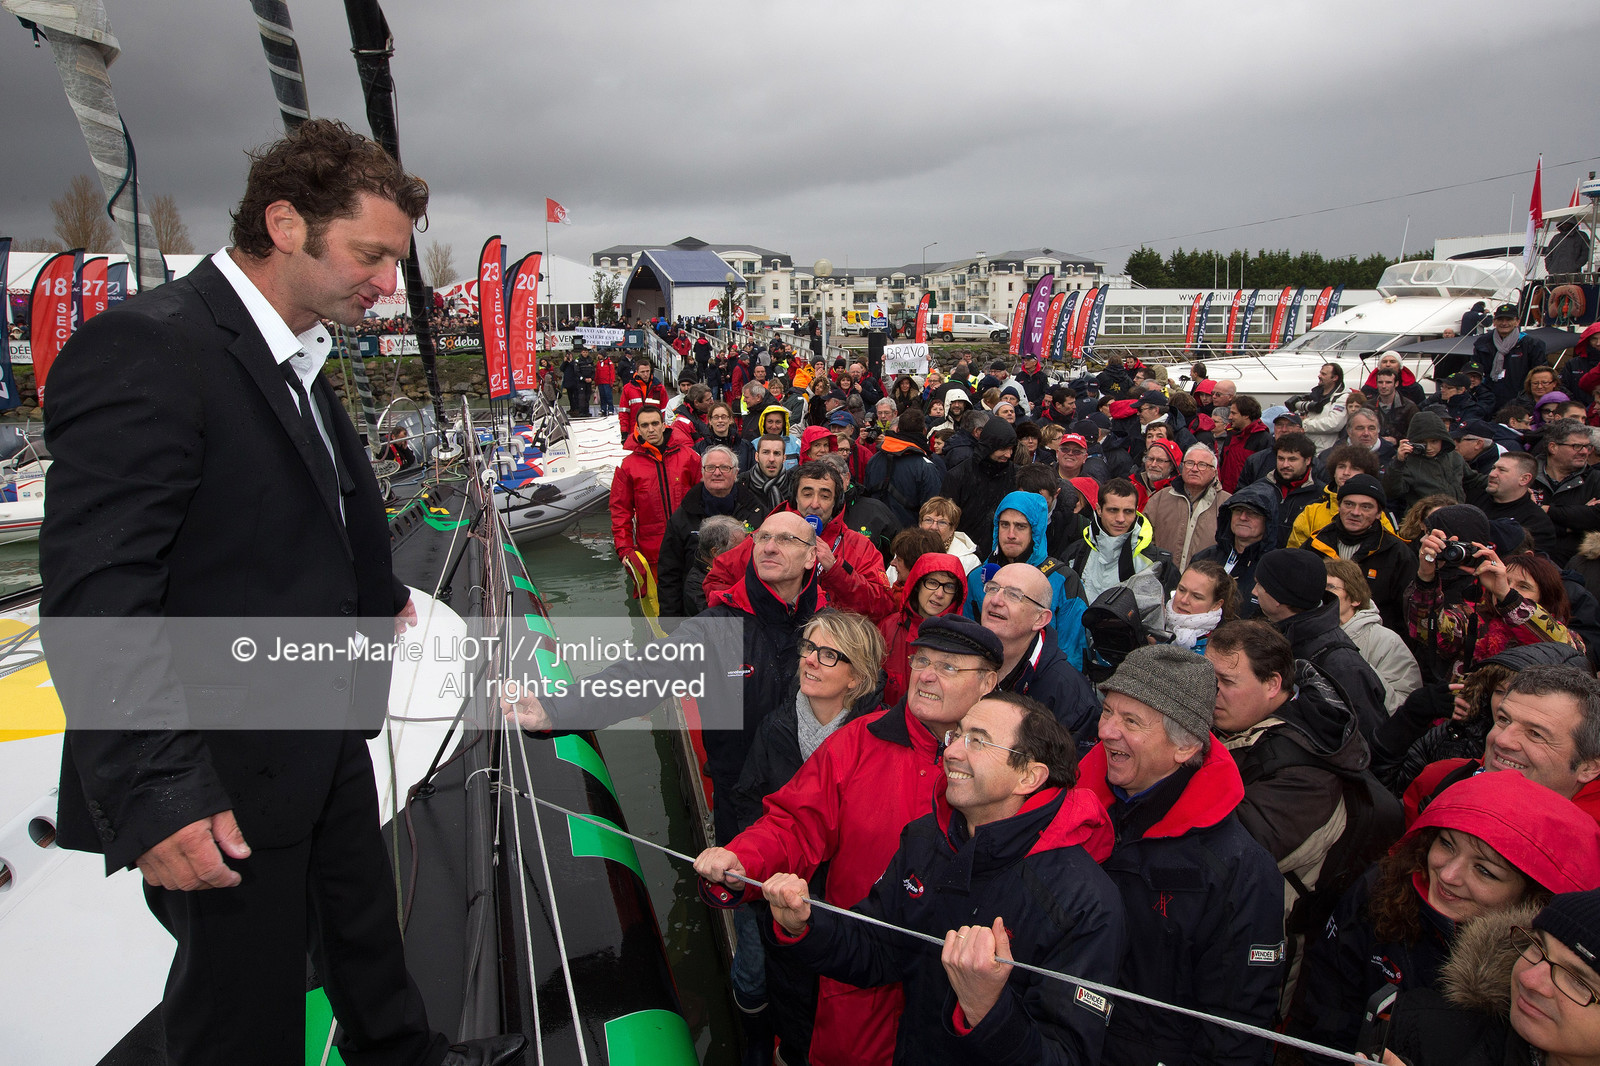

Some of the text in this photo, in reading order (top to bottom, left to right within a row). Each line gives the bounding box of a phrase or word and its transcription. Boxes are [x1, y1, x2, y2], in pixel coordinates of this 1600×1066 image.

[483, 263, 499, 281] 23
[41, 278, 67, 296] 18
[83, 280, 104, 296] 27
[517, 273, 536, 290] 20
[919, 302, 929, 311] 39
[1053, 301, 1059, 311] 8
[1084, 297, 1094, 307] 37
[1031, 286, 1048, 343] CREW
[56, 303, 67, 351] SECU
[1285, 309, 1296, 343] ODIAC
[494, 288, 508, 390] SECURITE
[526, 296, 535, 385] SECURITE
[10, 345, 31, 354] DÉE
[887, 346, 926, 361] BRAVO
